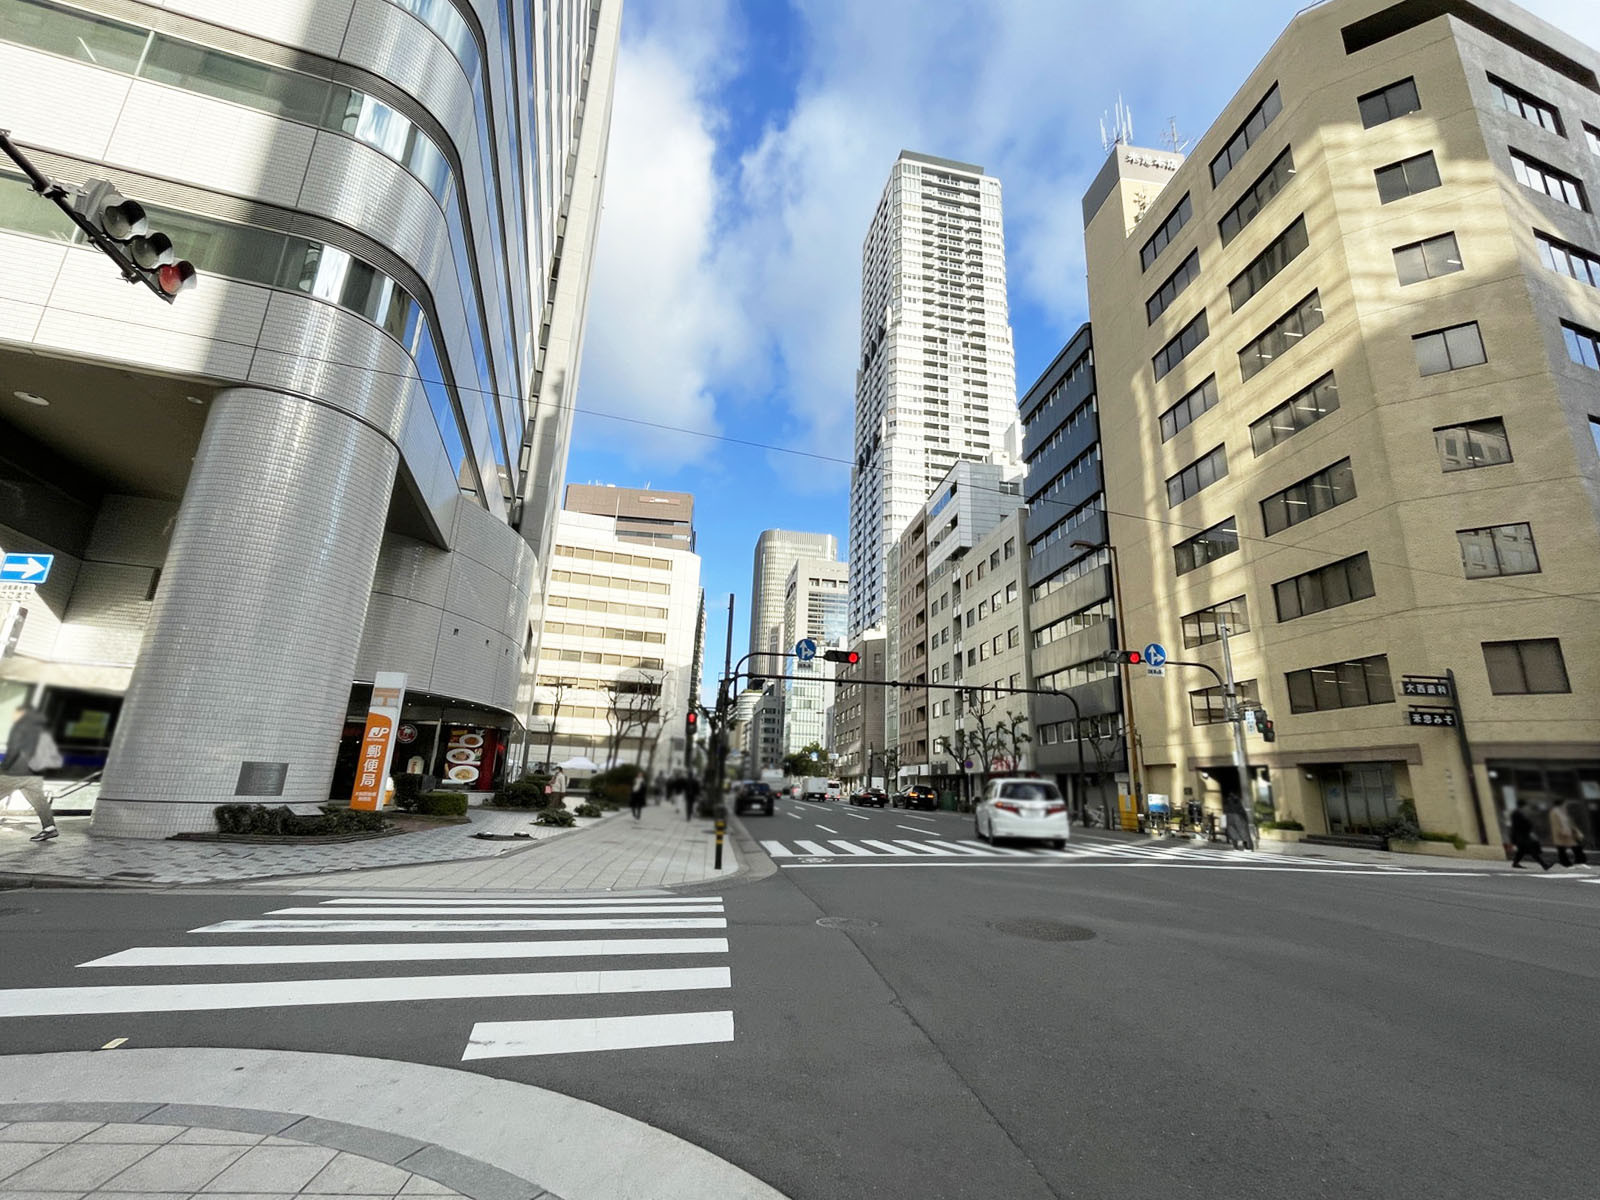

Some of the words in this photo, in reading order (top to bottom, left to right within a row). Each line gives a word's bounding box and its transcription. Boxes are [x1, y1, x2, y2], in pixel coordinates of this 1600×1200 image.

[1405, 683, 1447, 695] 大西歯科
[359, 744, 383, 788] 郵便局
